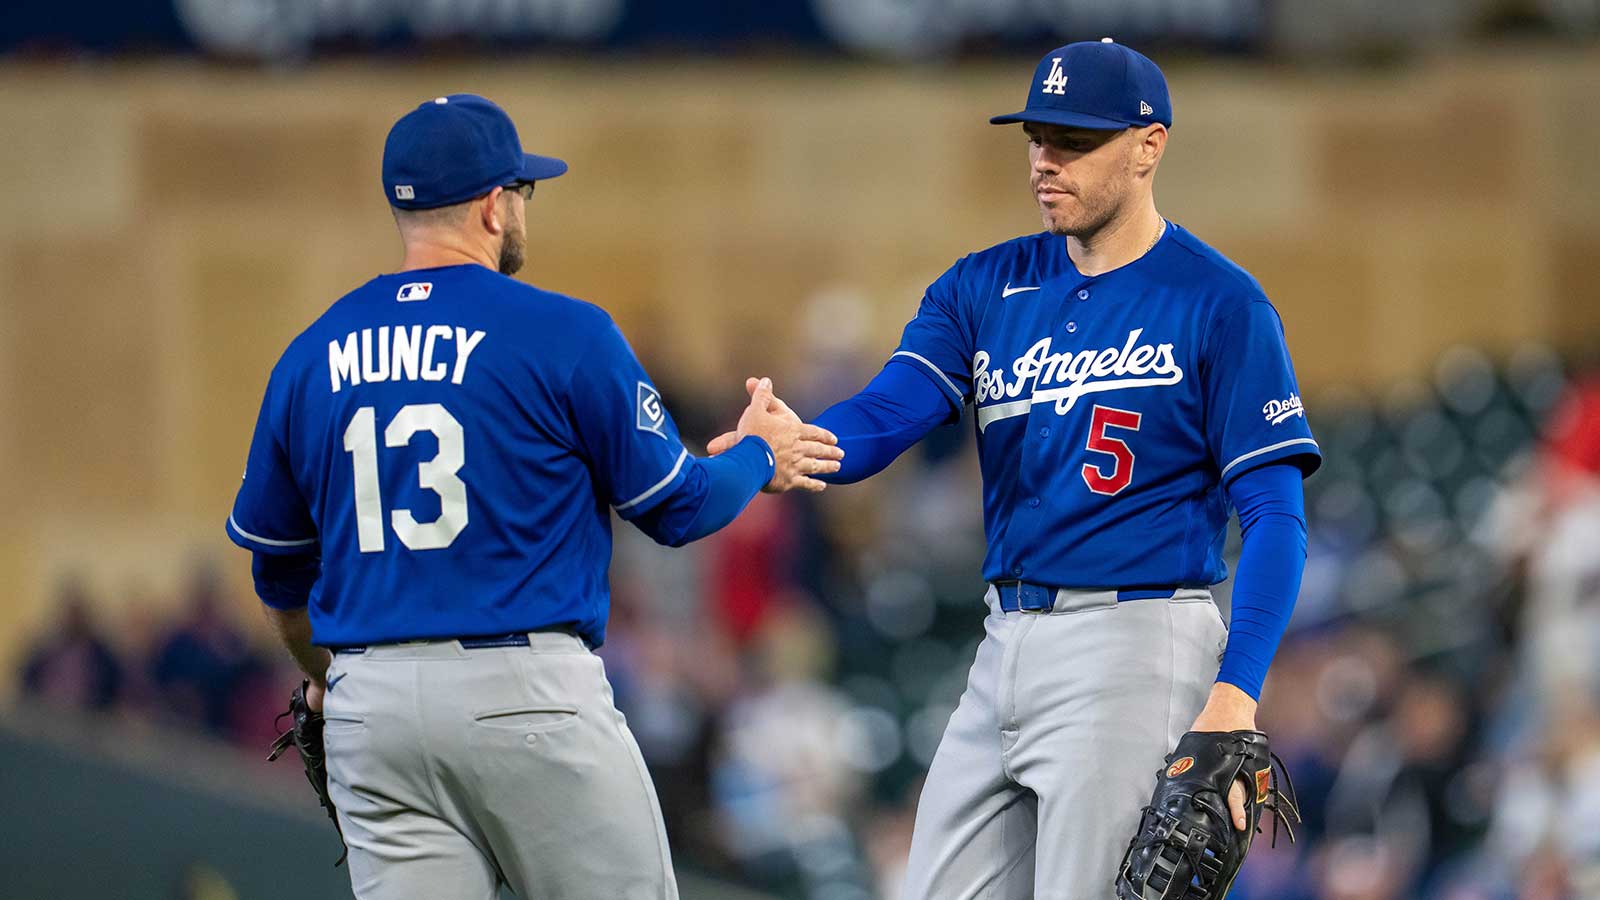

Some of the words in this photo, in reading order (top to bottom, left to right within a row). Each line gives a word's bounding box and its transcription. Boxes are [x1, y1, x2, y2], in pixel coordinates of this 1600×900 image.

[1042, 57, 1069, 95] LA
[328, 324, 487, 394] MUNCY
[1005, 327, 1184, 416] Angeles
[642, 393, 661, 422] G
[343, 403, 469, 553] 13
[1081, 403, 1142, 496] 5
